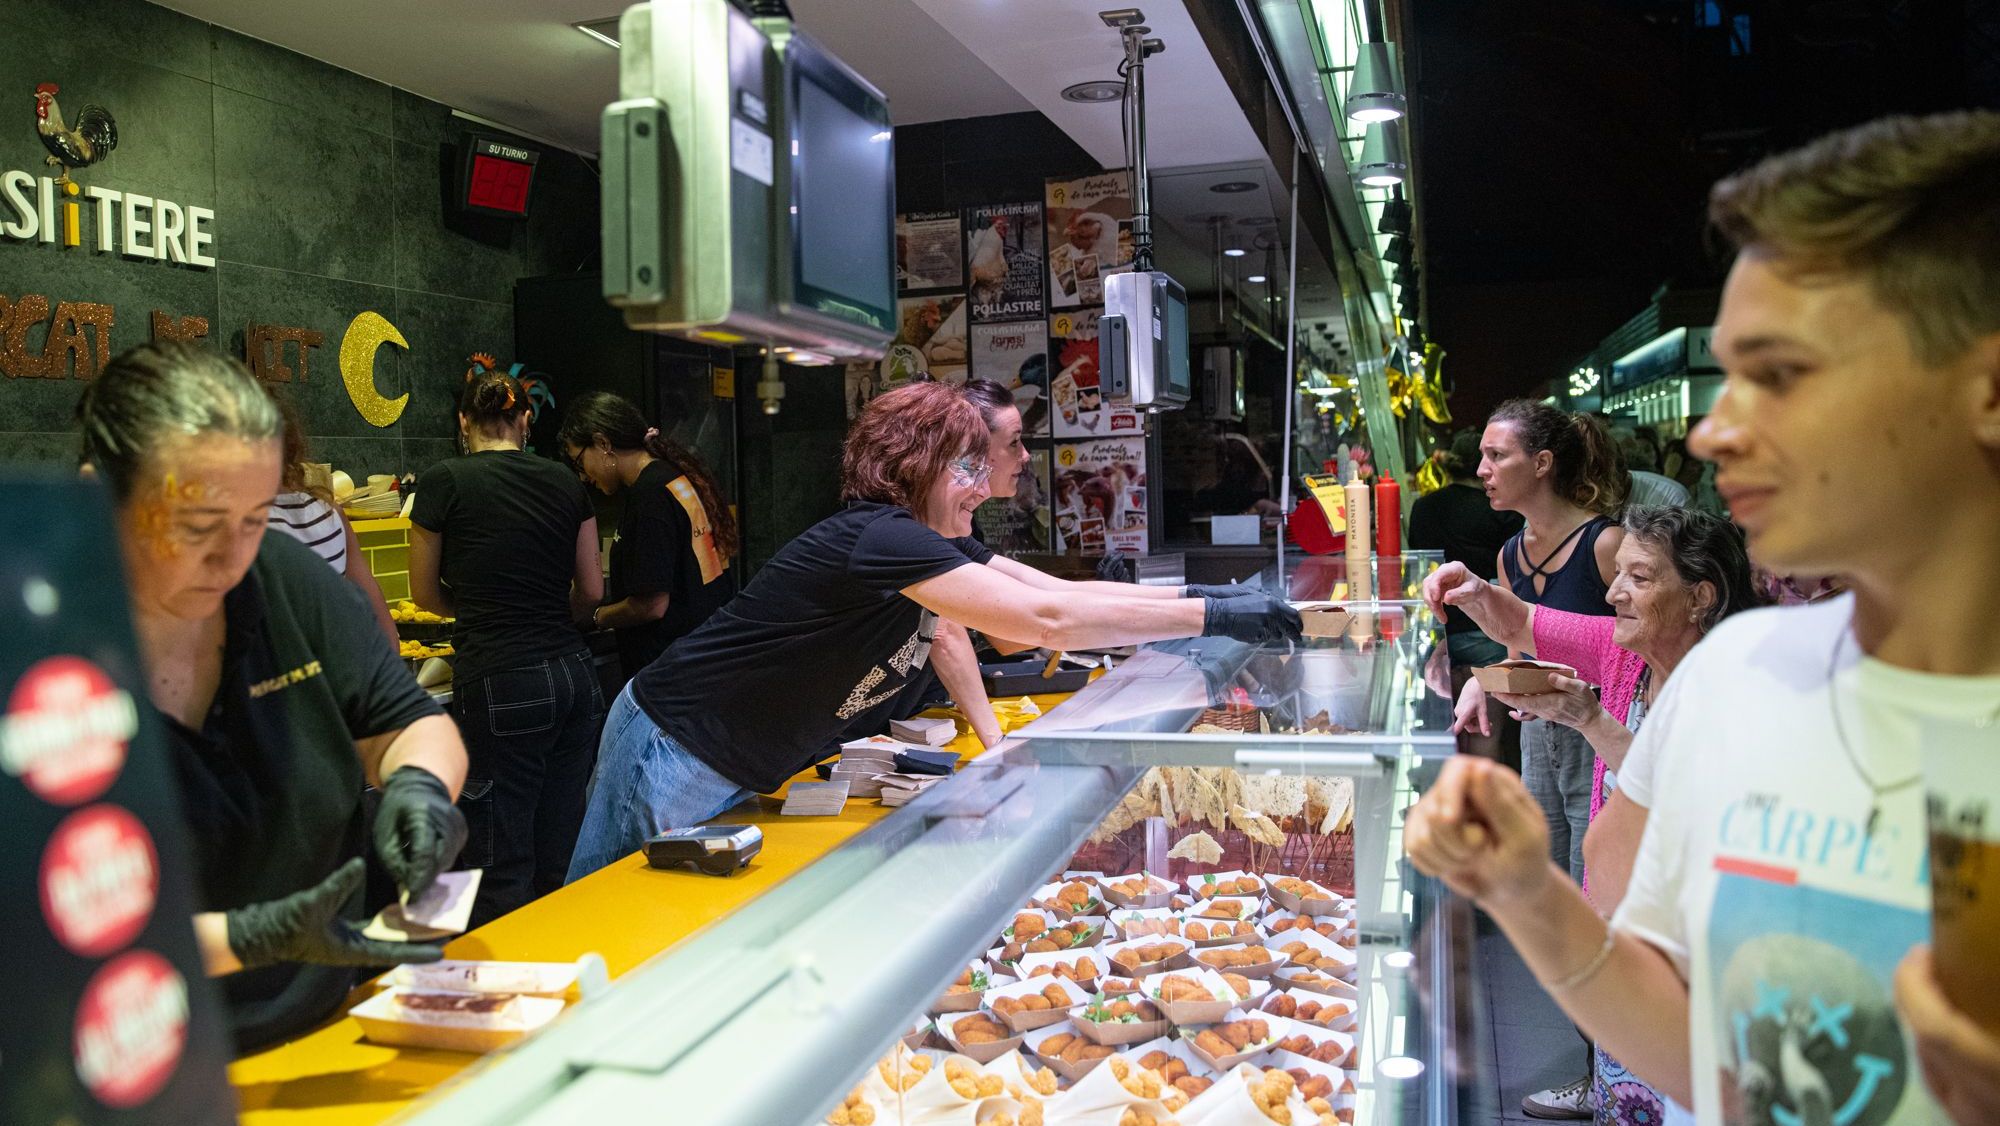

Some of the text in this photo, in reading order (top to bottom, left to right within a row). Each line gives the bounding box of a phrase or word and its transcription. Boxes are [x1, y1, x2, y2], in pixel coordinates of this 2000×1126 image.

[489, 144, 528, 160] SU TURNO
[0, 170, 55, 243] SI
[85, 186, 216, 268] TERE
[973, 300, 1042, 316] POLLASTRE
